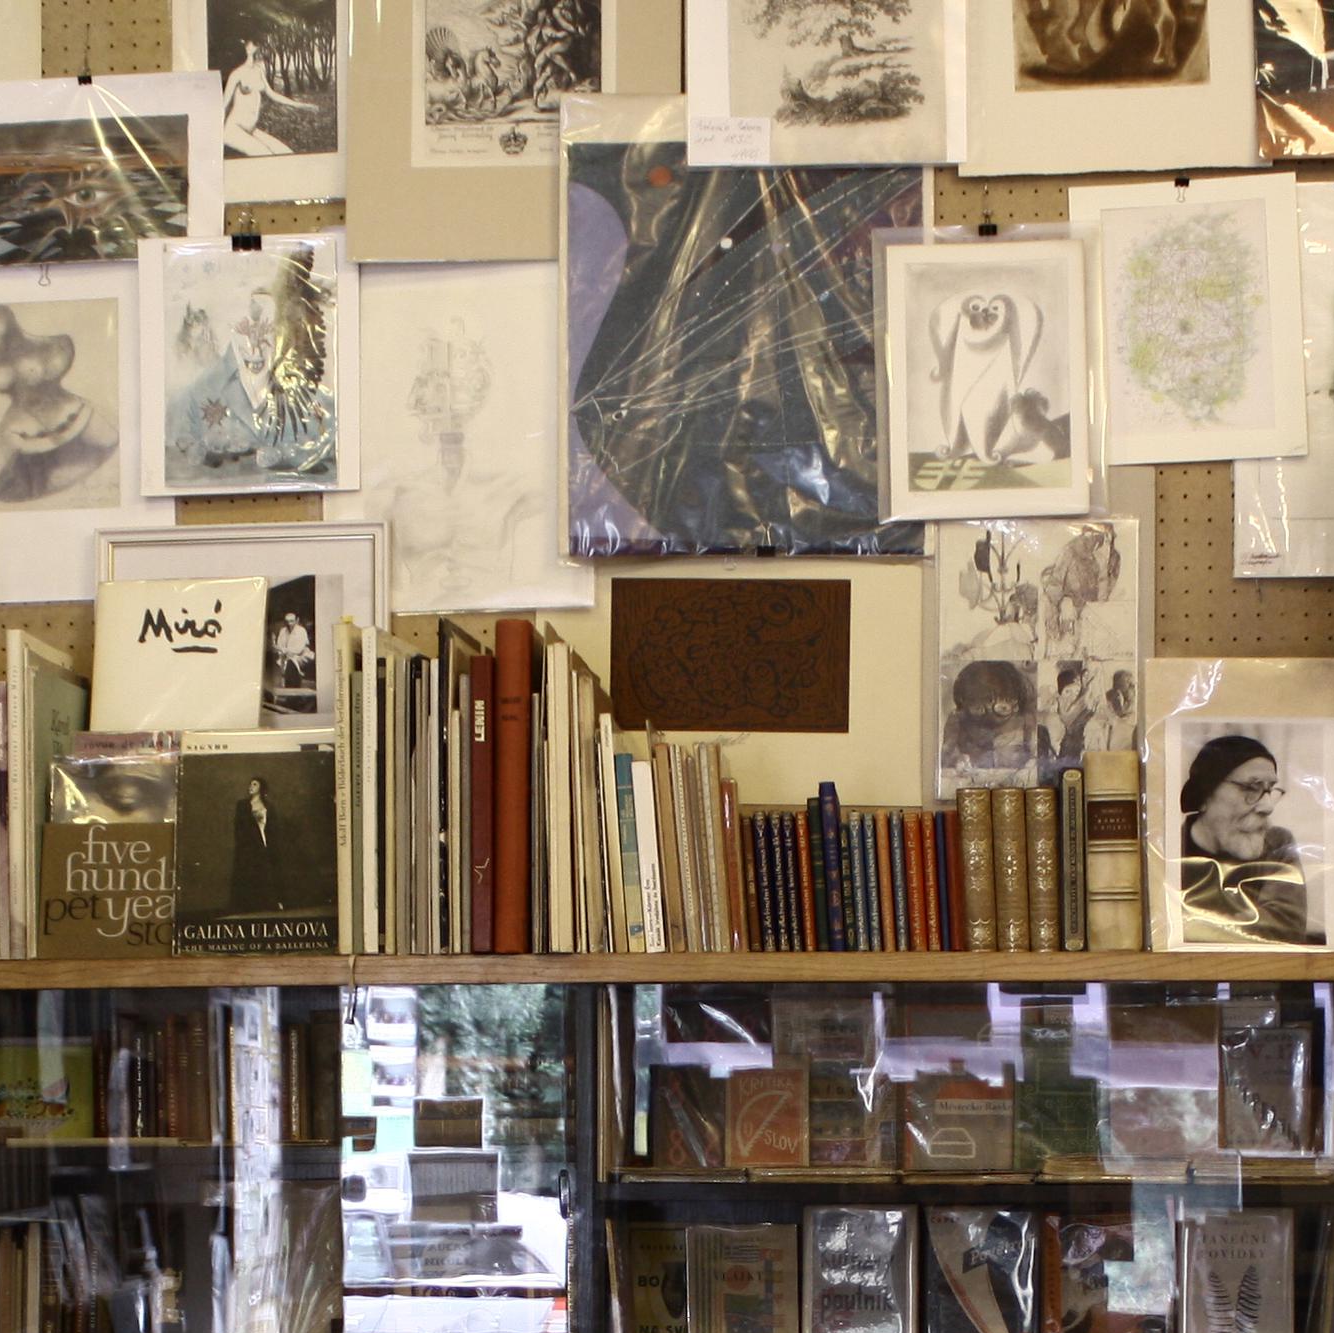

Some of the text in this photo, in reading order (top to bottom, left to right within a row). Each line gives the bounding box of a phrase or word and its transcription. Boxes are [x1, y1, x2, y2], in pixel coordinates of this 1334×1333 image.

[81, 825, 152, 865] five
[42, 892, 101, 936] pět
[184, 921, 329, 940] GALINA ULANOVA
